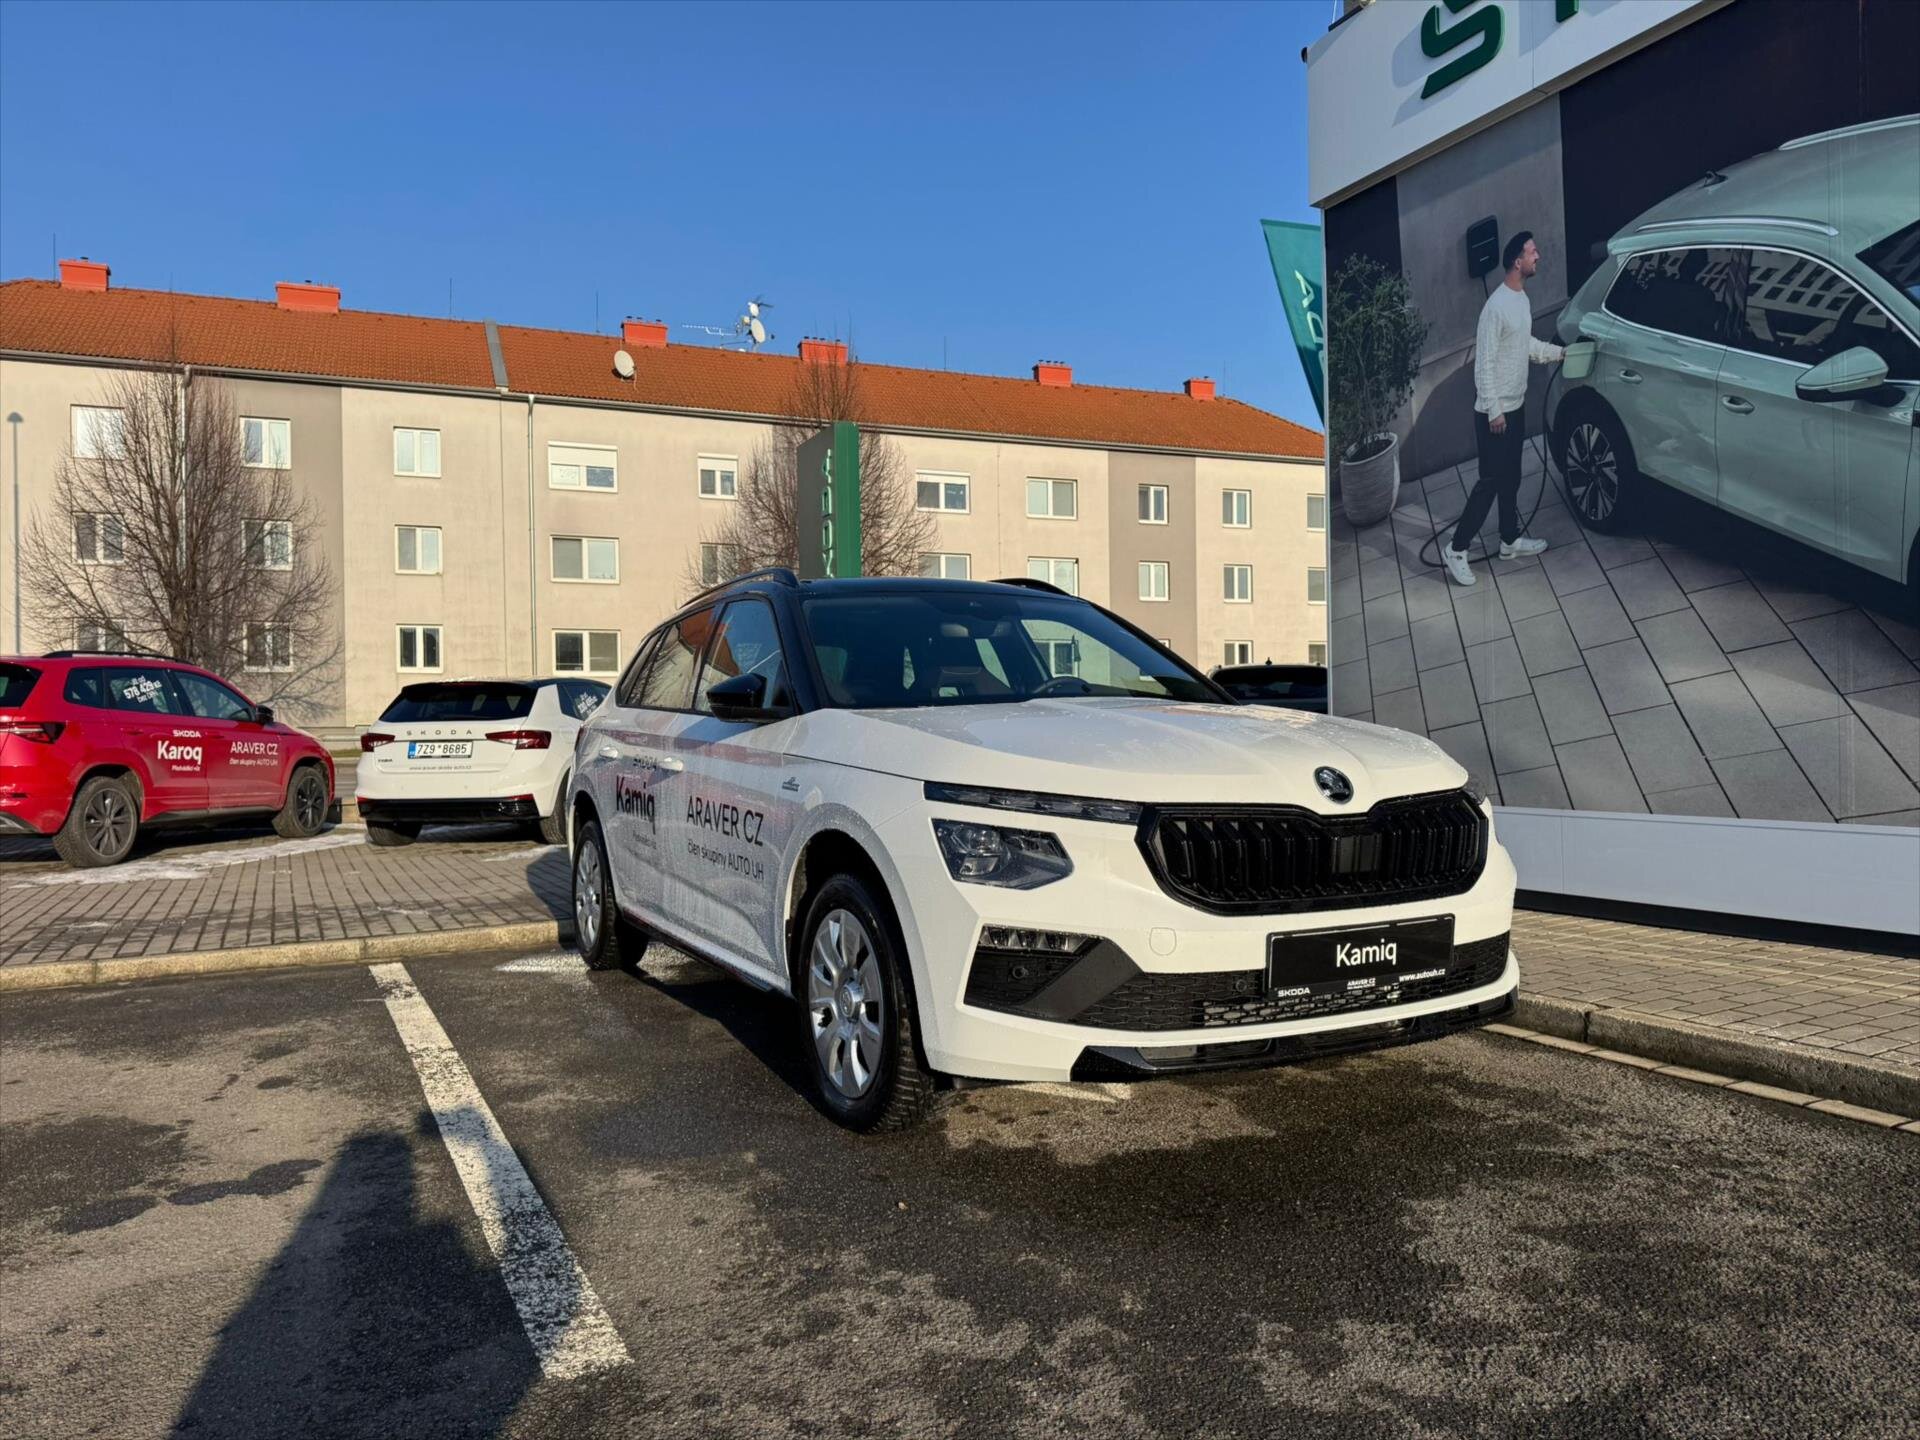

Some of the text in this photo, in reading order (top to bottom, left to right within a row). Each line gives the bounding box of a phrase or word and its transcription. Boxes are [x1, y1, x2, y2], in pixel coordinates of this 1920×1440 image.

[157, 740, 203, 765] Karoq
[230, 741, 279, 755] ARAVER CZ
[417, 743, 467, 755] 7Z9 8685
[616, 774, 656, 835] Kamiq
[686, 795, 764, 847] ARAVER CZ
[727, 853, 751, 875] AUTO
[751, 859, 765, 881] UH
[1336, 938, 1397, 968] Kamiq
[1399, 968, 1446, 983] www.autouh.cz
